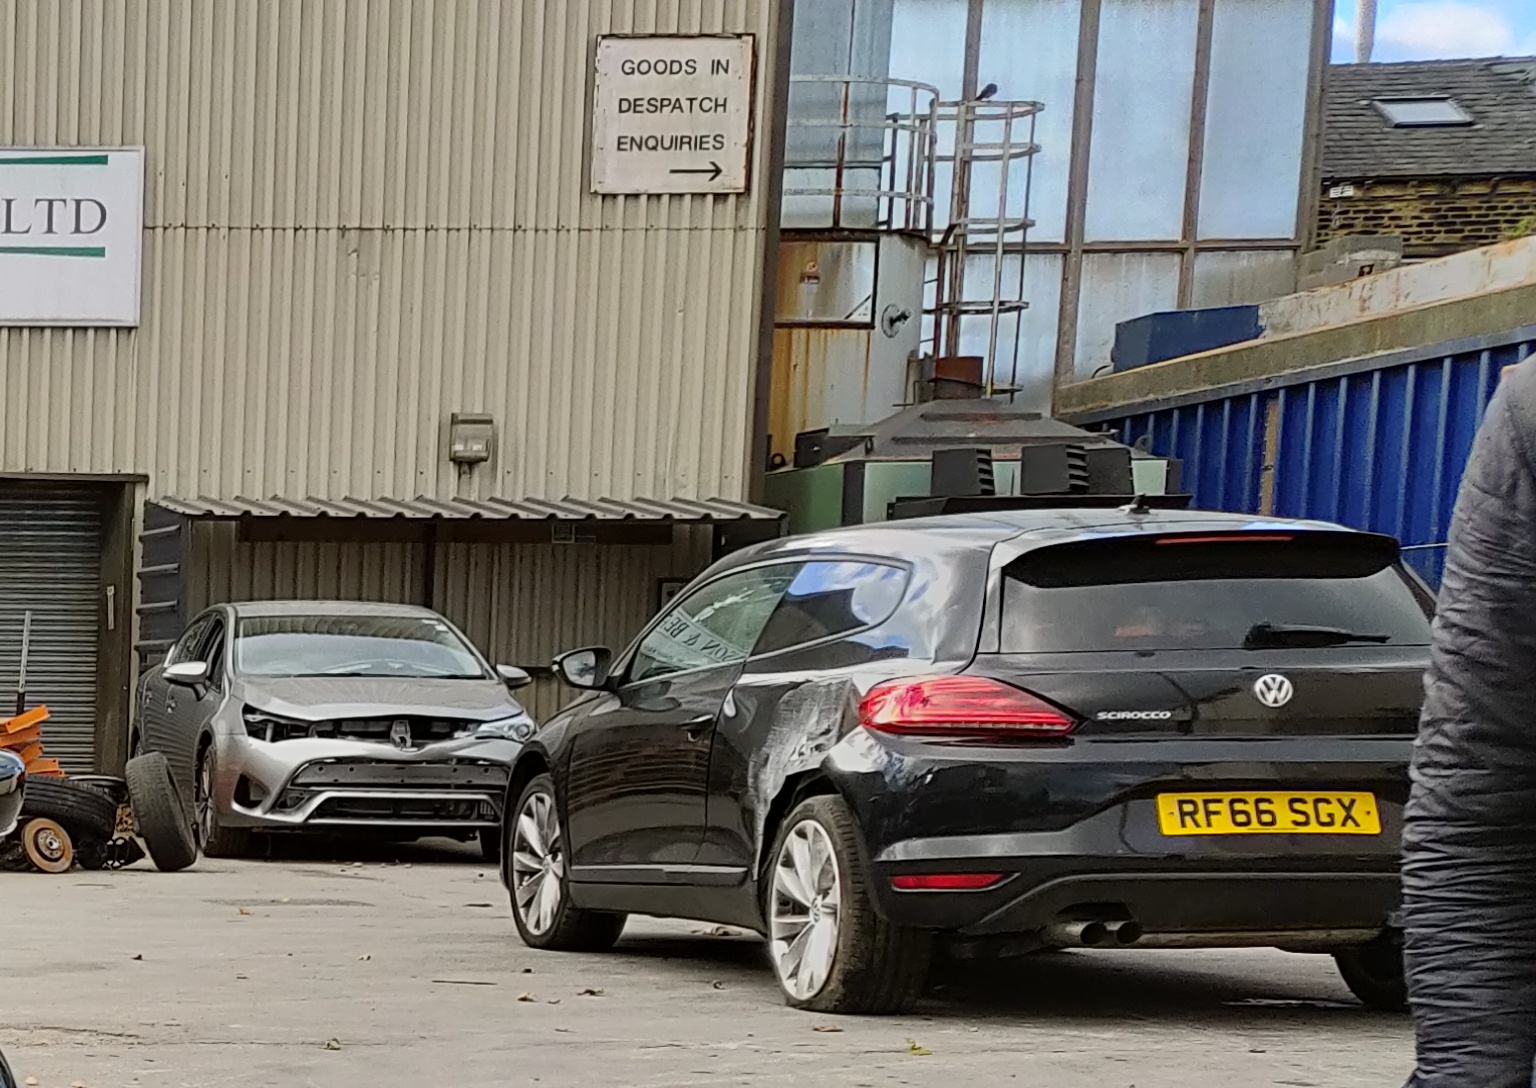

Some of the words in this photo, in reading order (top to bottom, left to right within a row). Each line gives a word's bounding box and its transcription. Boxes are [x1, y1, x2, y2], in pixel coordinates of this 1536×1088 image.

[621, 59, 697, 76] GOODS
[711, 59, 730, 75] IN
[618, 97, 728, 114] DESPATCH
[616, 134, 725, 151] ENQUIRIES
[0, 198, 108, 235] LTD
[1097, 710, 1172, 720] SCIROCCO
[1177, 798, 1278, 829] RF66
[1288, 798, 1361, 828] SGX
